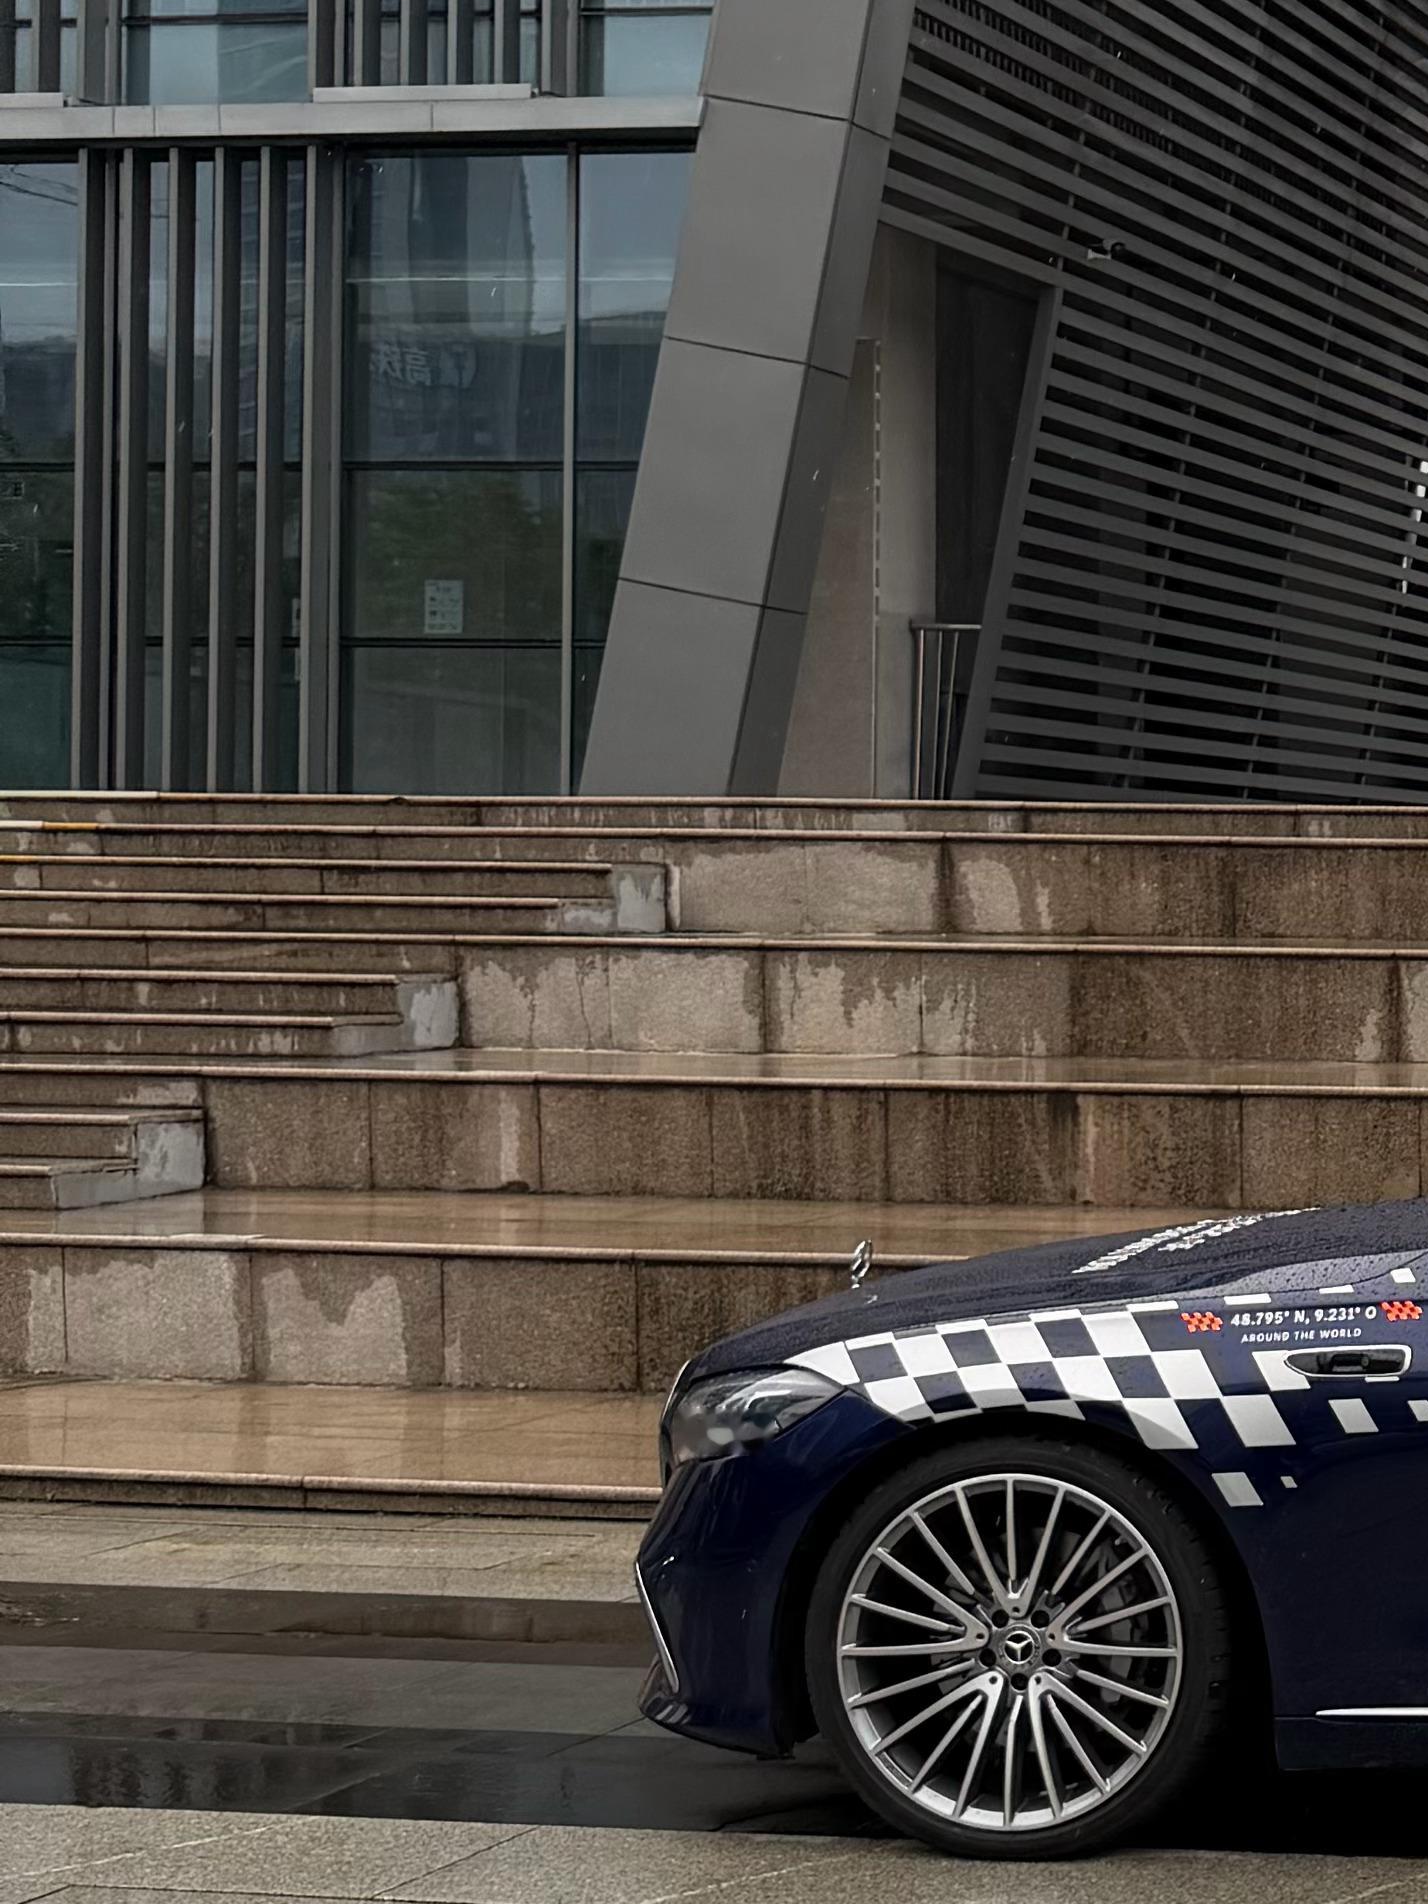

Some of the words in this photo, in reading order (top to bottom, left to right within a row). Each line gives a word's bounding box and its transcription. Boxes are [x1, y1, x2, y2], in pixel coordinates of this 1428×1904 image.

[1294, 1310, 1310, 1325] N,
[1240, 1330, 1290, 1344] AROUND
[1294, 1329, 1315, 1340] THE
[1319, 1328, 1362, 1339] WORLD
